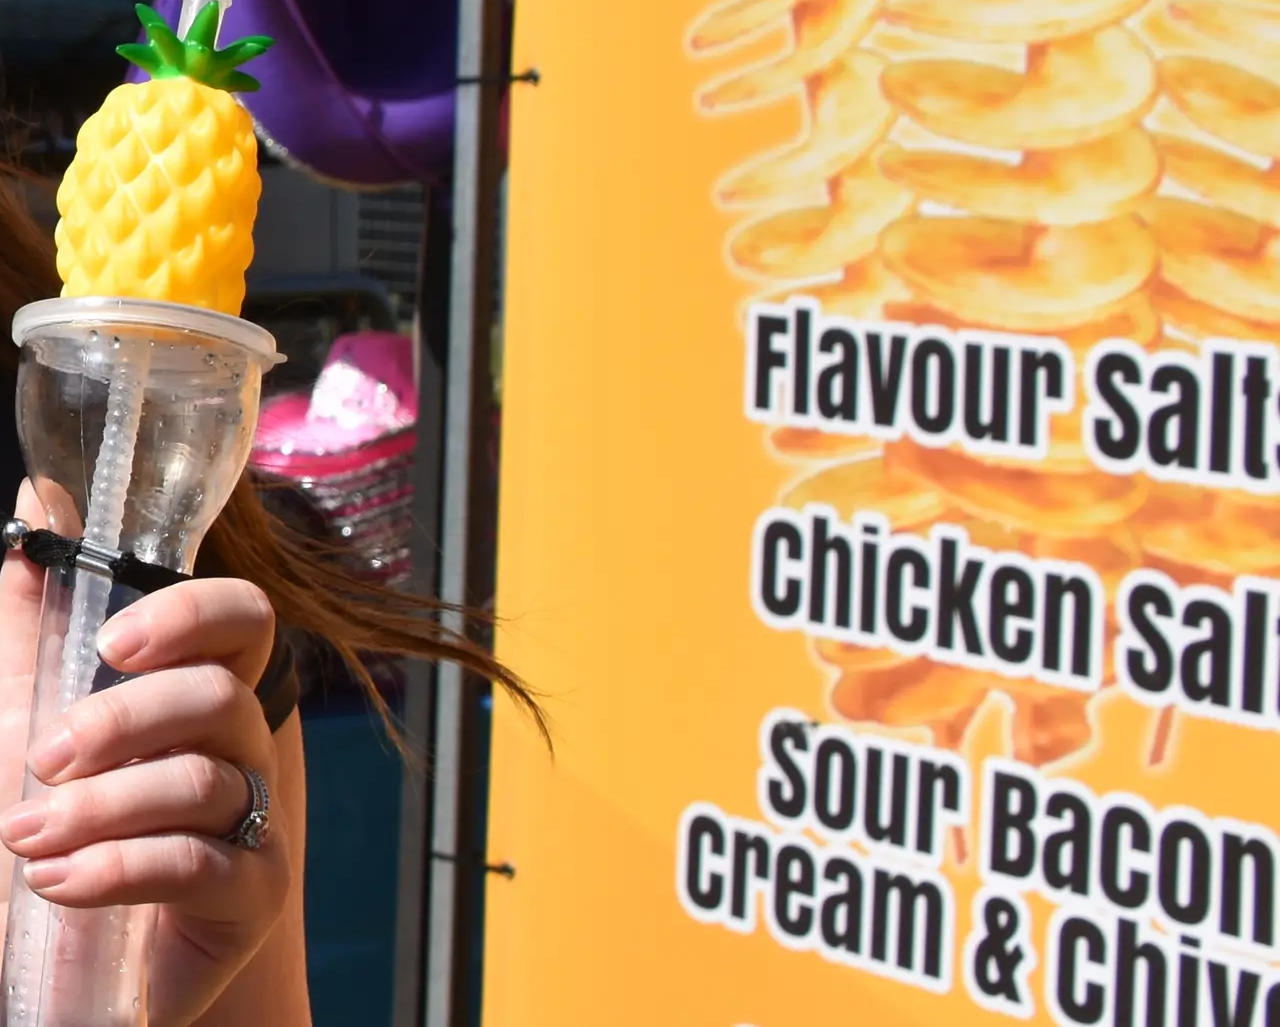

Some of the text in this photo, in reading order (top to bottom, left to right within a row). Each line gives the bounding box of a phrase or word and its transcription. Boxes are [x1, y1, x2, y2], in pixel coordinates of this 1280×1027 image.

[754, 308, 1280, 481] Flavour Salt
[760, 516, 1280, 717] Chicken Sal
[685, 814, 945, 980] Cream
[974, 897, 1026, 1006] &
[766, 720, 1274, 948] Sour Bacon
